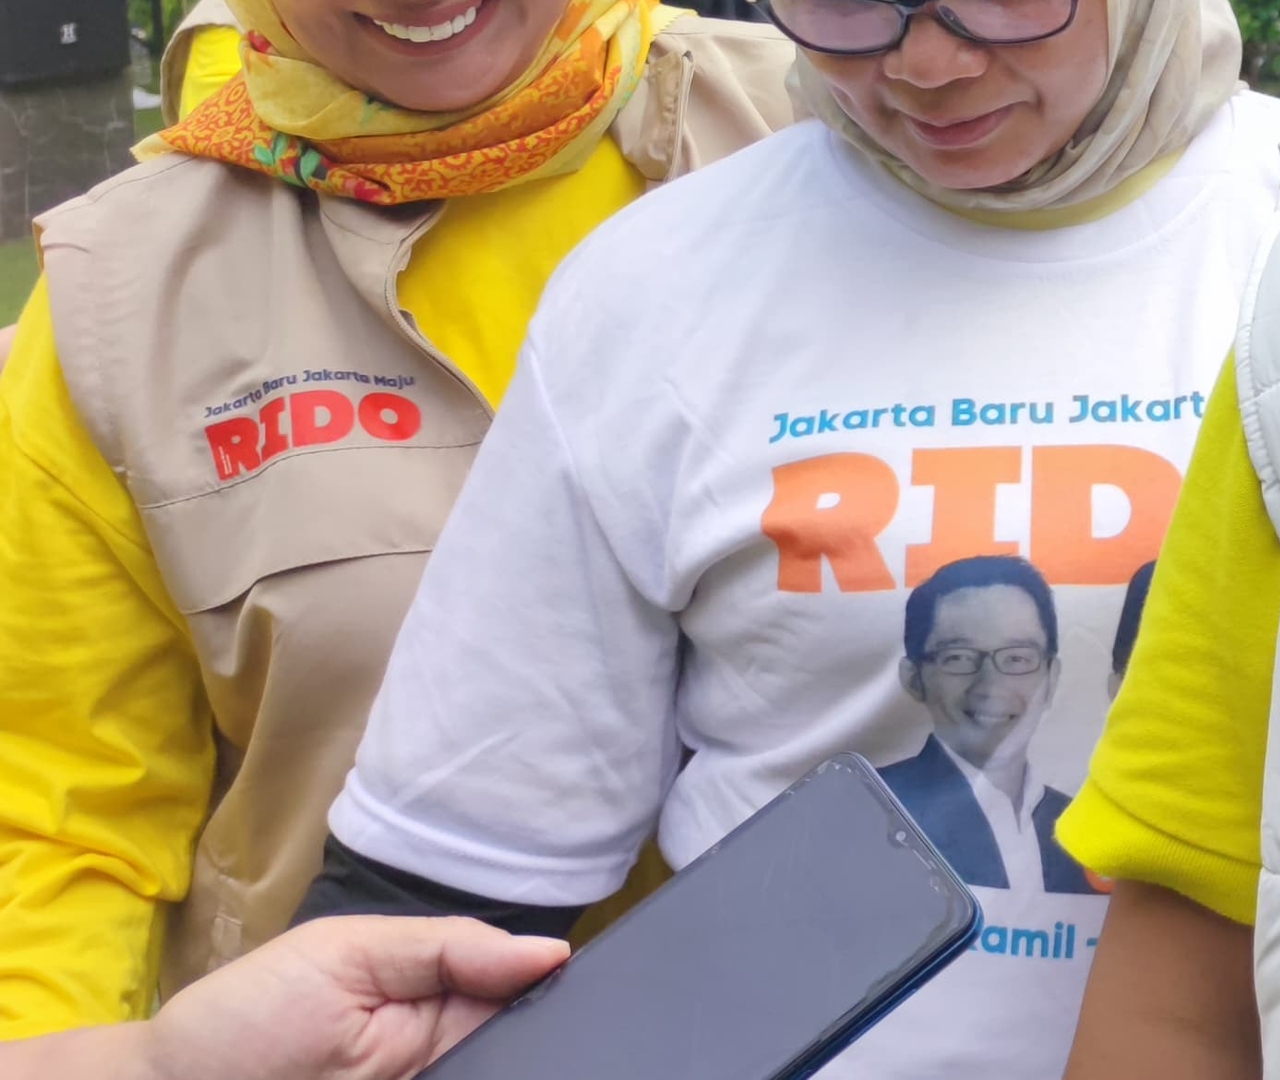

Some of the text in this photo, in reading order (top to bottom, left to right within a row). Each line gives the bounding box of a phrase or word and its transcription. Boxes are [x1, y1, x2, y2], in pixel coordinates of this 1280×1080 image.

[204, 369, 415, 419] Jakarta Baru Jakarta Maju
[768, 391, 1206, 444] Jakarta Baru Jakart
[204, 389, 422, 482] RIDO
[760, 444, 1185, 594] RID
[969, 920, 1076, 959] amil
